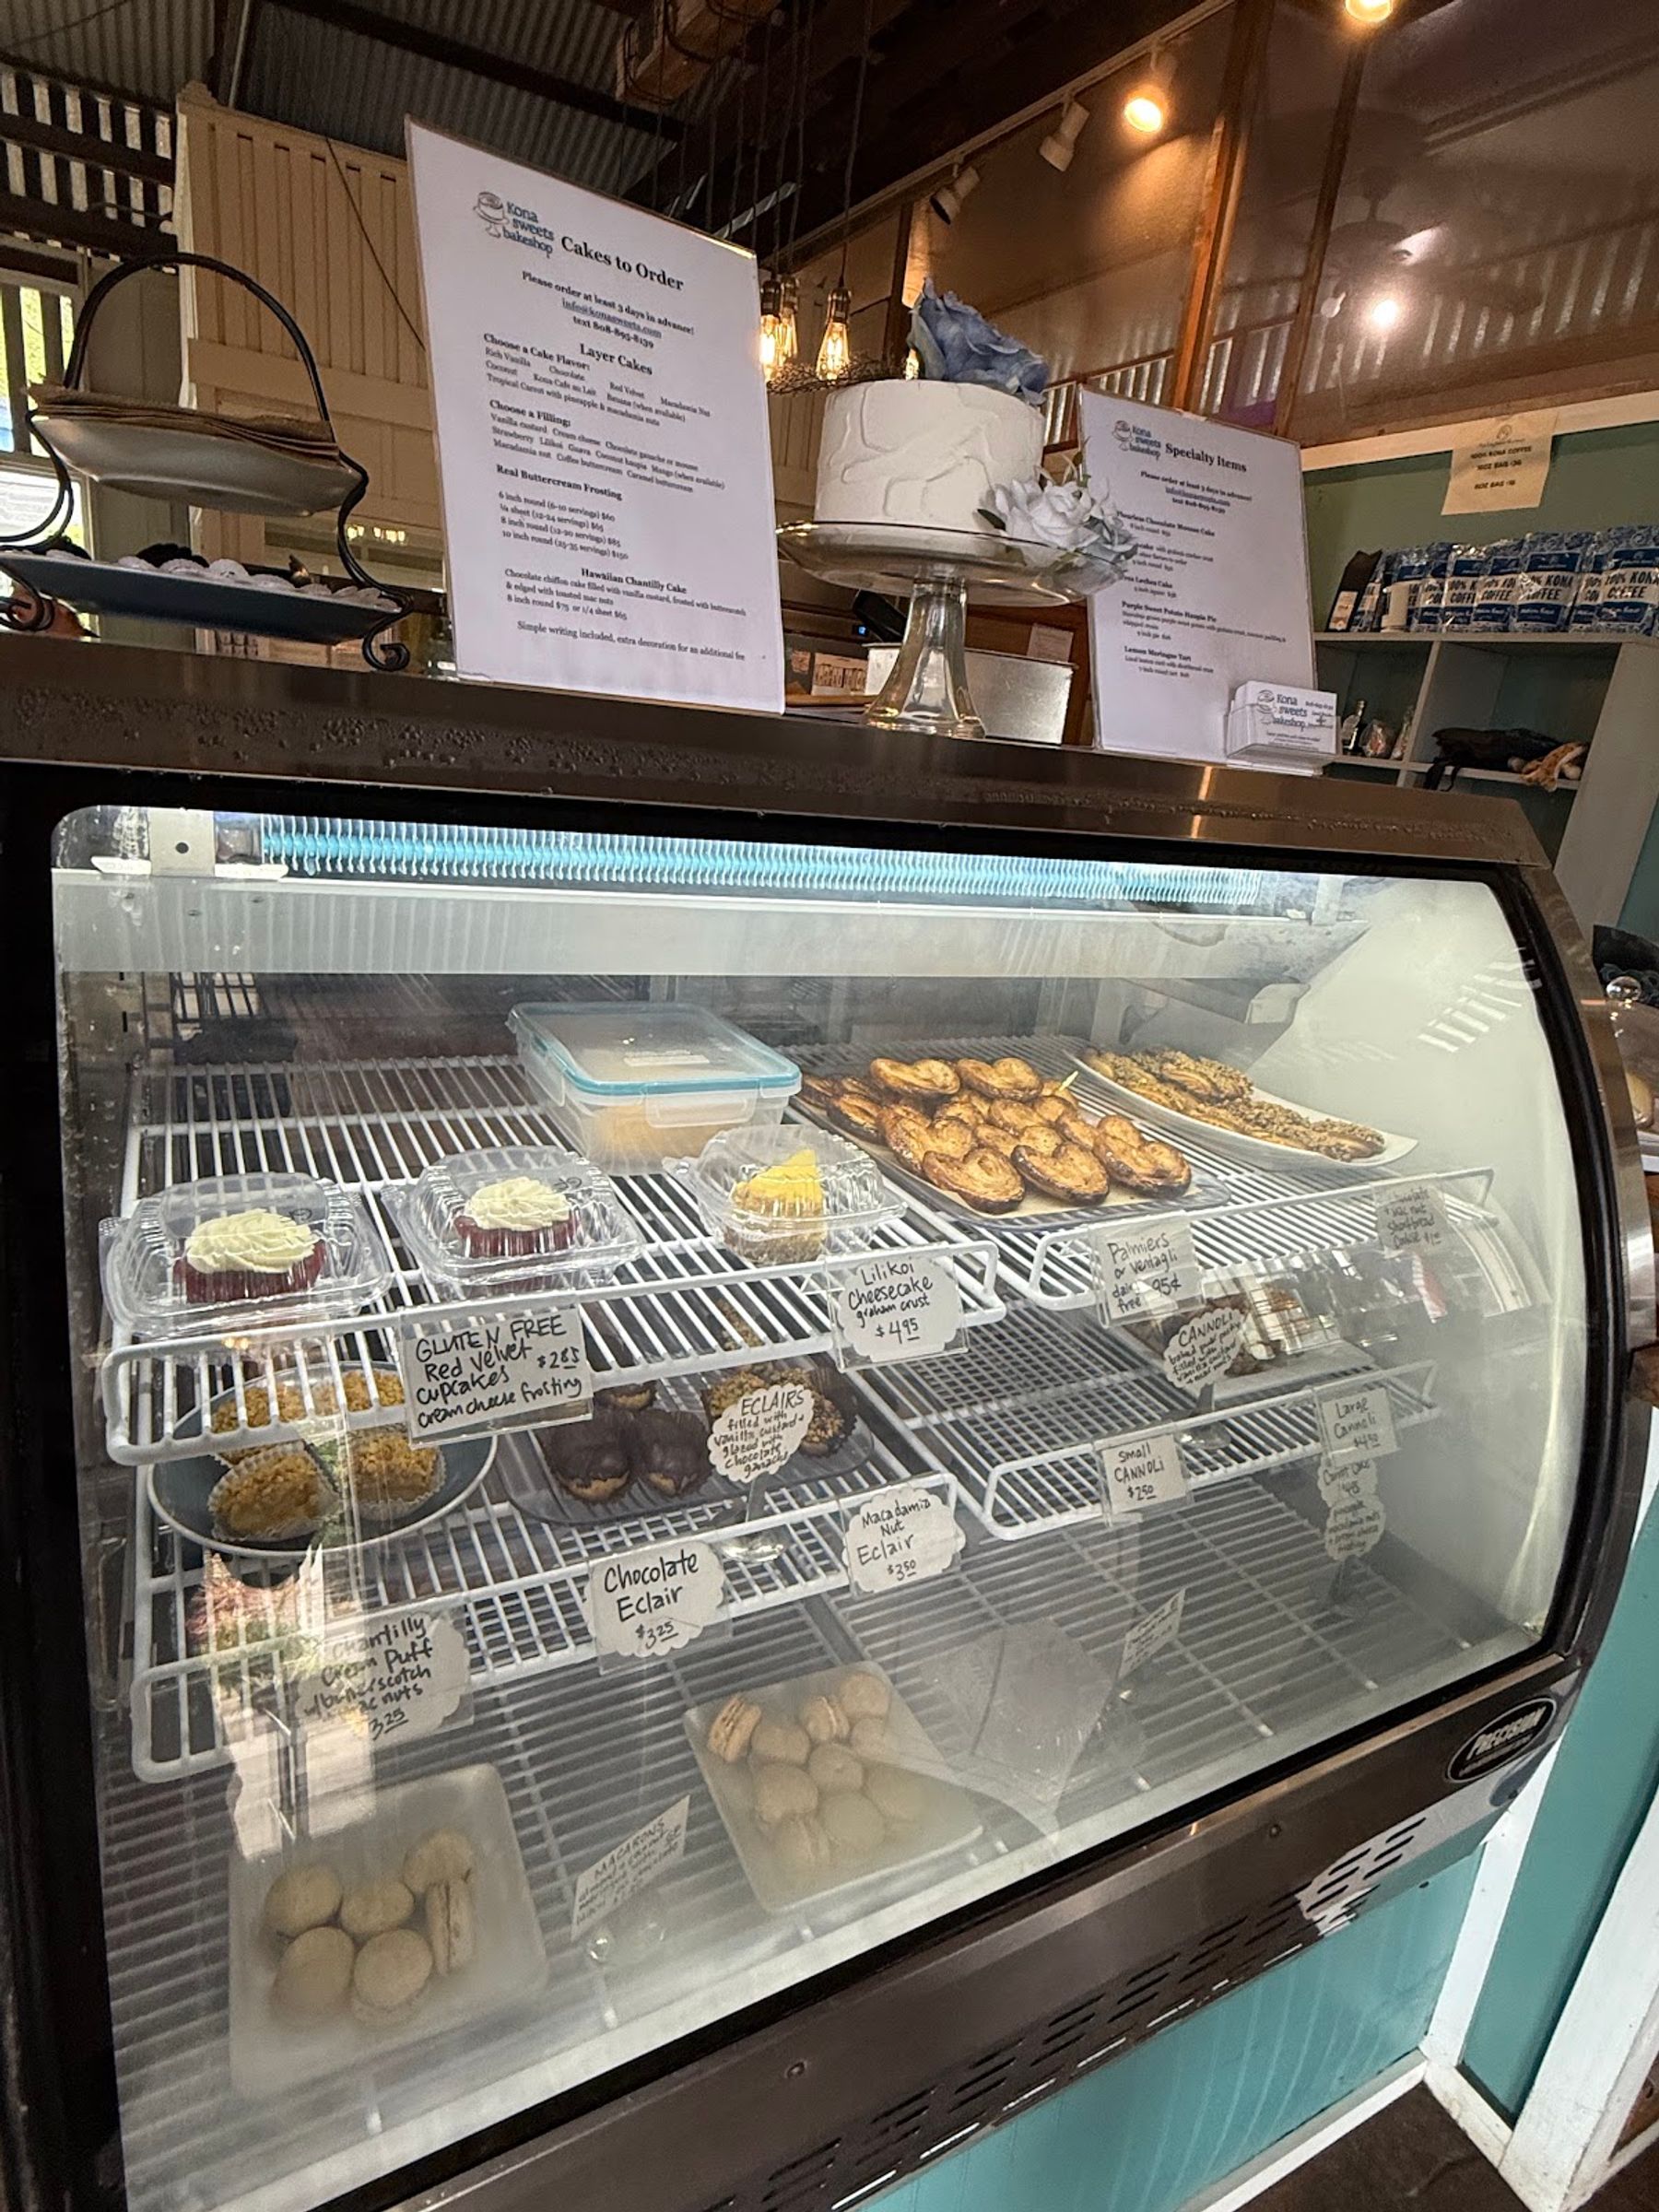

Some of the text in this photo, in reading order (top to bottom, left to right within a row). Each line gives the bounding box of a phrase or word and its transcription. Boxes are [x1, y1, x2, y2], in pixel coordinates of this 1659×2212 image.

[507, 202, 538, 223] Kona
[502, 226, 553, 258] bakeshop
[512, 218, 554, 241] sweets
[561, 236, 683, 289] Cakes to Order
[523, 271, 553, 288] Please
[555, 285, 581, 297] order
[594, 295, 616, 309] least
[625, 306, 645, 319] days
[658, 318, 693, 335] advance!
[573, 316, 591, 328] text
[484, 334, 520, 351] Choose
[530, 347, 553, 361] Cake
[557, 354, 590, 371] Flavor:
[581, 344, 653, 375] Layer Cakes
[549, 366, 585, 381] Chocolate
[489, 400, 525, 416] Choose
[536, 411, 571, 428] Filling:
[1166, 443, 1246, 472] Specialty Items
[1488, 445, 1531, 457] KONA COFFEE
[497, 465, 622, 501] Real Buttercream Frosting
[505, 492, 522, 502] inch
[524, 498, 546, 507] round
[511, 506, 530, 517] sheet
[508, 518, 524, 527] inch
[526, 523, 548, 533] round
[513, 532, 529, 541] inch
[531, 536, 553, 546] round
[505, 569, 542, 581] Chocolate
[544, 575, 569, 585] chiffon
[588, 582, 605, 592] filled
[514, 582, 535, 594] edged
[538, 587, 554, 595] with
[582, 568, 686, 594] Hawaiian Chantilly Cake
[514, 595, 530, 605] inch
[532, 599, 554, 608] round
[595, 607, 612, 616] sheet
[1482, 590, 1513, 601] COFFEE
[518, 621, 547, 634] Simple
[549, 627, 578, 639] writing
[580, 629, 616, 642] included,
[617, 637, 636, 645] extra
[638, 638, 677, 651] decoration
[678, 643, 688, 652] for
[700, 647, 734, 658] additional
[1277, 694, 1298, 706] Kona
[1278, 706, 1308, 717] sweets
[1107, 1232, 1170, 1264] Palmiers
[861, 1256, 914, 1287] Lilikoi
[1114, 1266, 1125, 1279] or
[855, 1294, 931, 1328] graham crust
[1118, 1296, 1142, 1313] free
[416, 1315, 568, 1363] GLUTEN FREE
[1179, 1312, 1233, 1347] CANNOLI
[424, 1359, 463, 1382] Red
[521, 1376, 582, 1404] frosting
[741, 1389, 805, 1416] ECLAIRS
[727, 1410, 788, 1431] filled with
[1335, 1396, 1369, 1419] Large
[1334, 1411, 1377, 1440] Cannoli
[724, 1442, 782, 1469] chocolate
[744, 1450, 788, 1479] ganache
[862, 1498, 931, 1529] Macadamia
[880, 1521, 905, 1537] Nut
[856, 1534, 914, 1566] Eclair
[604, 1548, 700, 1594] Chocolate
[617, 1585, 684, 1623] Eclair
[382, 1683, 423, 1705] nuts
